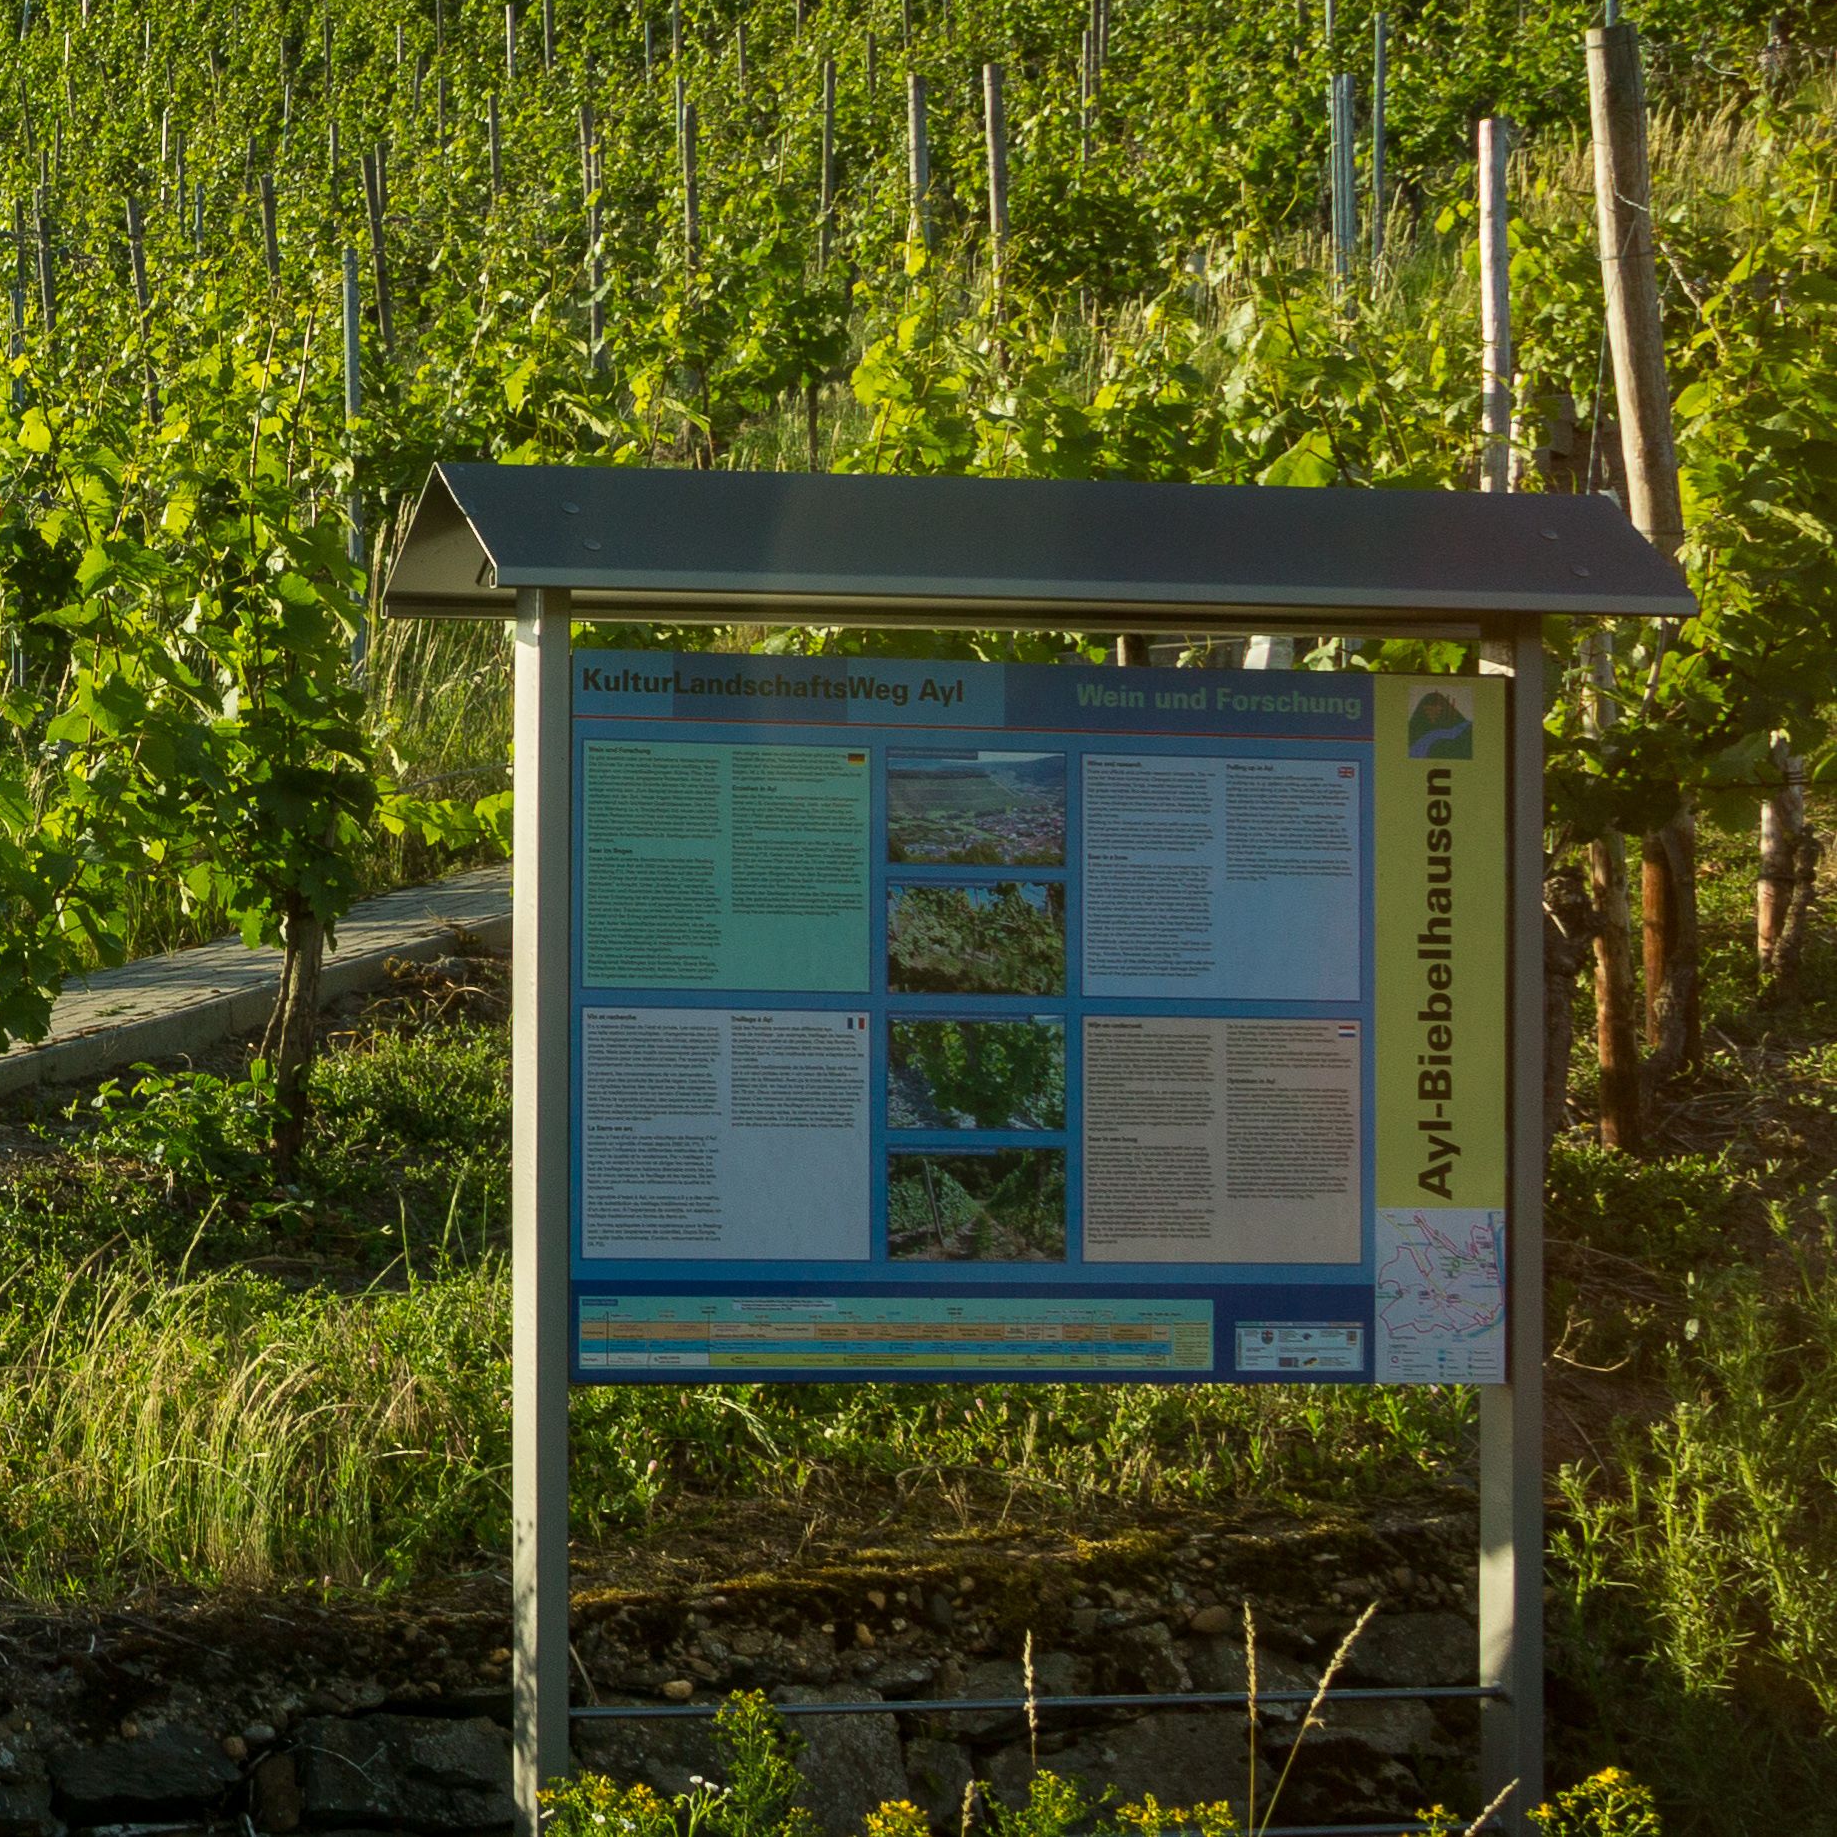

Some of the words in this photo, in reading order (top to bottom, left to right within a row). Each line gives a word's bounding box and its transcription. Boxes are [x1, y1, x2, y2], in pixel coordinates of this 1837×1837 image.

[582, 667, 910, 706] KulturLandschaftsWeg
[918, 678, 964, 707] Ayl
[1077, 683, 1145, 708] Wein
[1155, 687, 1207, 711] und
[1216, 687, 1362, 720] Forschung
[1417, 767, 1461, 1201] Ayl-Biebelhausen
